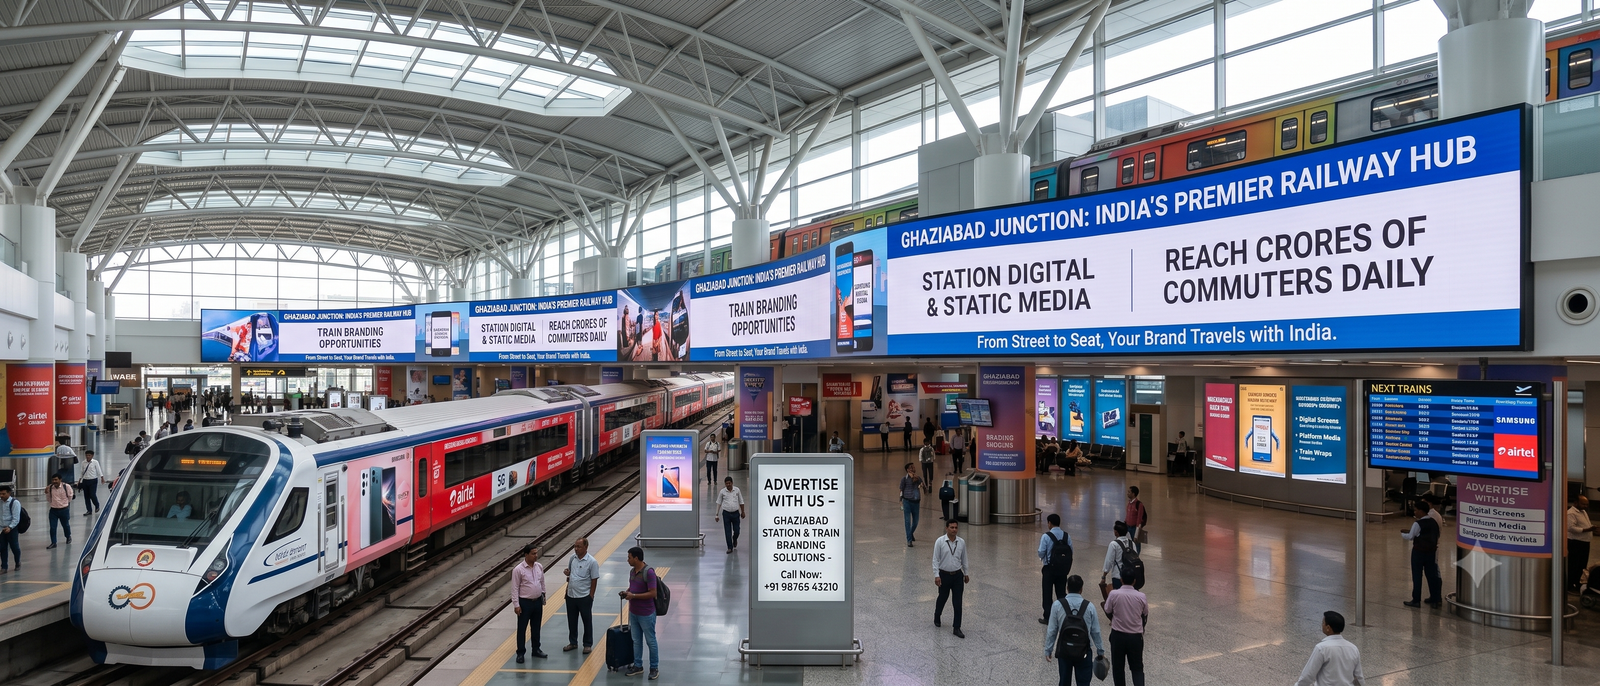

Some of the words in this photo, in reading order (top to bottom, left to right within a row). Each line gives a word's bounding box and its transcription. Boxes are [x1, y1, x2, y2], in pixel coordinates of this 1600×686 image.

[901, 221, 986, 249] GHAZIABAD
[990, 207, 1089, 238] JUNCTION:
[1096, 195, 1168, 225] INDIA'S
[1174, 176, 1273, 215] PREMIER
[1280, 148, 1402, 196] RAILWAY
[1410, 134, 1477, 173] HUB
[1165, 239, 1247, 272] REACH
[1256, 223, 1372, 263] CRORES
[1382, 215, 1427, 248] OF
[695, 279, 726, 294] GHAZIABAD
[727, 275, 755, 289] JUNCTION:
[755, 269, 774, 285] INDIA'S
[775, 264, 796, 280] PREMIER
[796, 259, 817, 275] RAILWAY
[817, 254, 826, 268] HUB
[922, 266, 1001, 291] STATION
[1008, 258, 1095, 285] DIGITAL
[1163, 266, 1332, 304] COMMUTERS
[1342, 255, 1434, 292] DAILY
[475, 304, 508, 314] GHAZIABAD
[508, 302, 537, 312] JUNCTION:
[538, 300, 556, 311] INDIA'S
[557, 298, 579, 309] PREMIER
[579, 296, 602, 308] RAILWAY
[602, 295, 613, 305] HUB
[728, 300, 755, 318] TRAIN
[756, 293, 798, 315] BRANDING
[926, 297, 939, 317] &
[943, 292, 1012, 316] STATIC
[1019, 288, 1091, 313] MEDIA
[363, 311, 383, 319] PREMIER
[383, 310, 402, 318] RAILWAY
[402, 309, 412, 317] HUB
[481, 323, 509, 333] STATION
[510, 322, 536, 332] DIGITAL
[549, 319, 570, 331] REACH
[571, 318, 598, 330] CRORES
[599, 317, 608, 328] OF
[731, 316, 796, 336] OPPORTUNITIES
[317, 327, 343, 337] TRAIN
[344, 326, 384, 337] BRANDING
[977, 334, 1009, 349] From
[1011, 333, 1052, 348] Street
[1053, 333, 1067, 347] to
[1069, 332, 1104, 349] Seat,
[1107, 331, 1142, 346] Your
[1144, 329, 1186, 345] Brand
[1189, 328, 1245, 345] Travels
[1249, 325, 1285, 343] with
[1289, 323, 1337, 342] India.
[482, 335, 487, 345] &
[488, 335, 512, 344] STATIC
[513, 334, 536, 344] MEDIA
[547, 332, 589, 344] COMMUTERS
[589, 331, 608, 343] DAILY
[319, 338, 381, 349] OPPORTUNITIES
[714, 349, 725, 357] From
[726, 348, 738, 357] Street
[738, 349, 743, 357] to
[754, 348, 763, 356] Your
[764, 347, 776, 356] Brand
[1371, 384, 1396, 393] NEXT
[1397, 384, 1432, 394] TRAINS
[28, 412, 47, 420] airtel
[1299, 415, 1316, 424] Digital
[1317, 416, 1339, 424] Screens
[1496, 416, 1536, 425] SAMSUNG
[1299, 432, 1322, 440] Platform
[1313, 449, 1332, 458] Wraps
[1507, 446, 1535, 458] airtel
[764, 478, 839, 490] ADVERTISE
[1465, 482, 1529, 496] ADVERTISE
[457, 482, 476, 505] airtel
[767, 495, 803, 507] WITH
[807, 495, 825, 507] US
[1474, 494, 1499, 503] WITH
[1501, 497, 1516, 505] US
[1468, 505, 1490, 516] Digital
[1492, 509, 1525, 518] Screens
[773, 516, 829, 525] GHAZIABAD
[1498, 521, 1526, 531] Media
[762, 528, 801, 538] STATION
[803, 528, 810, 538] &
[812, 528, 840, 538] TRAIN
[776, 541, 826, 550] BRANDING
[773, 553, 825, 562] SOLUTIONS
[781, 570, 797, 579] Call
[799, 570, 822, 579] Now:
[764, 582, 779, 592] +91
[781, 582, 810, 592] 98765
[811, 582, 839, 592] 43210
